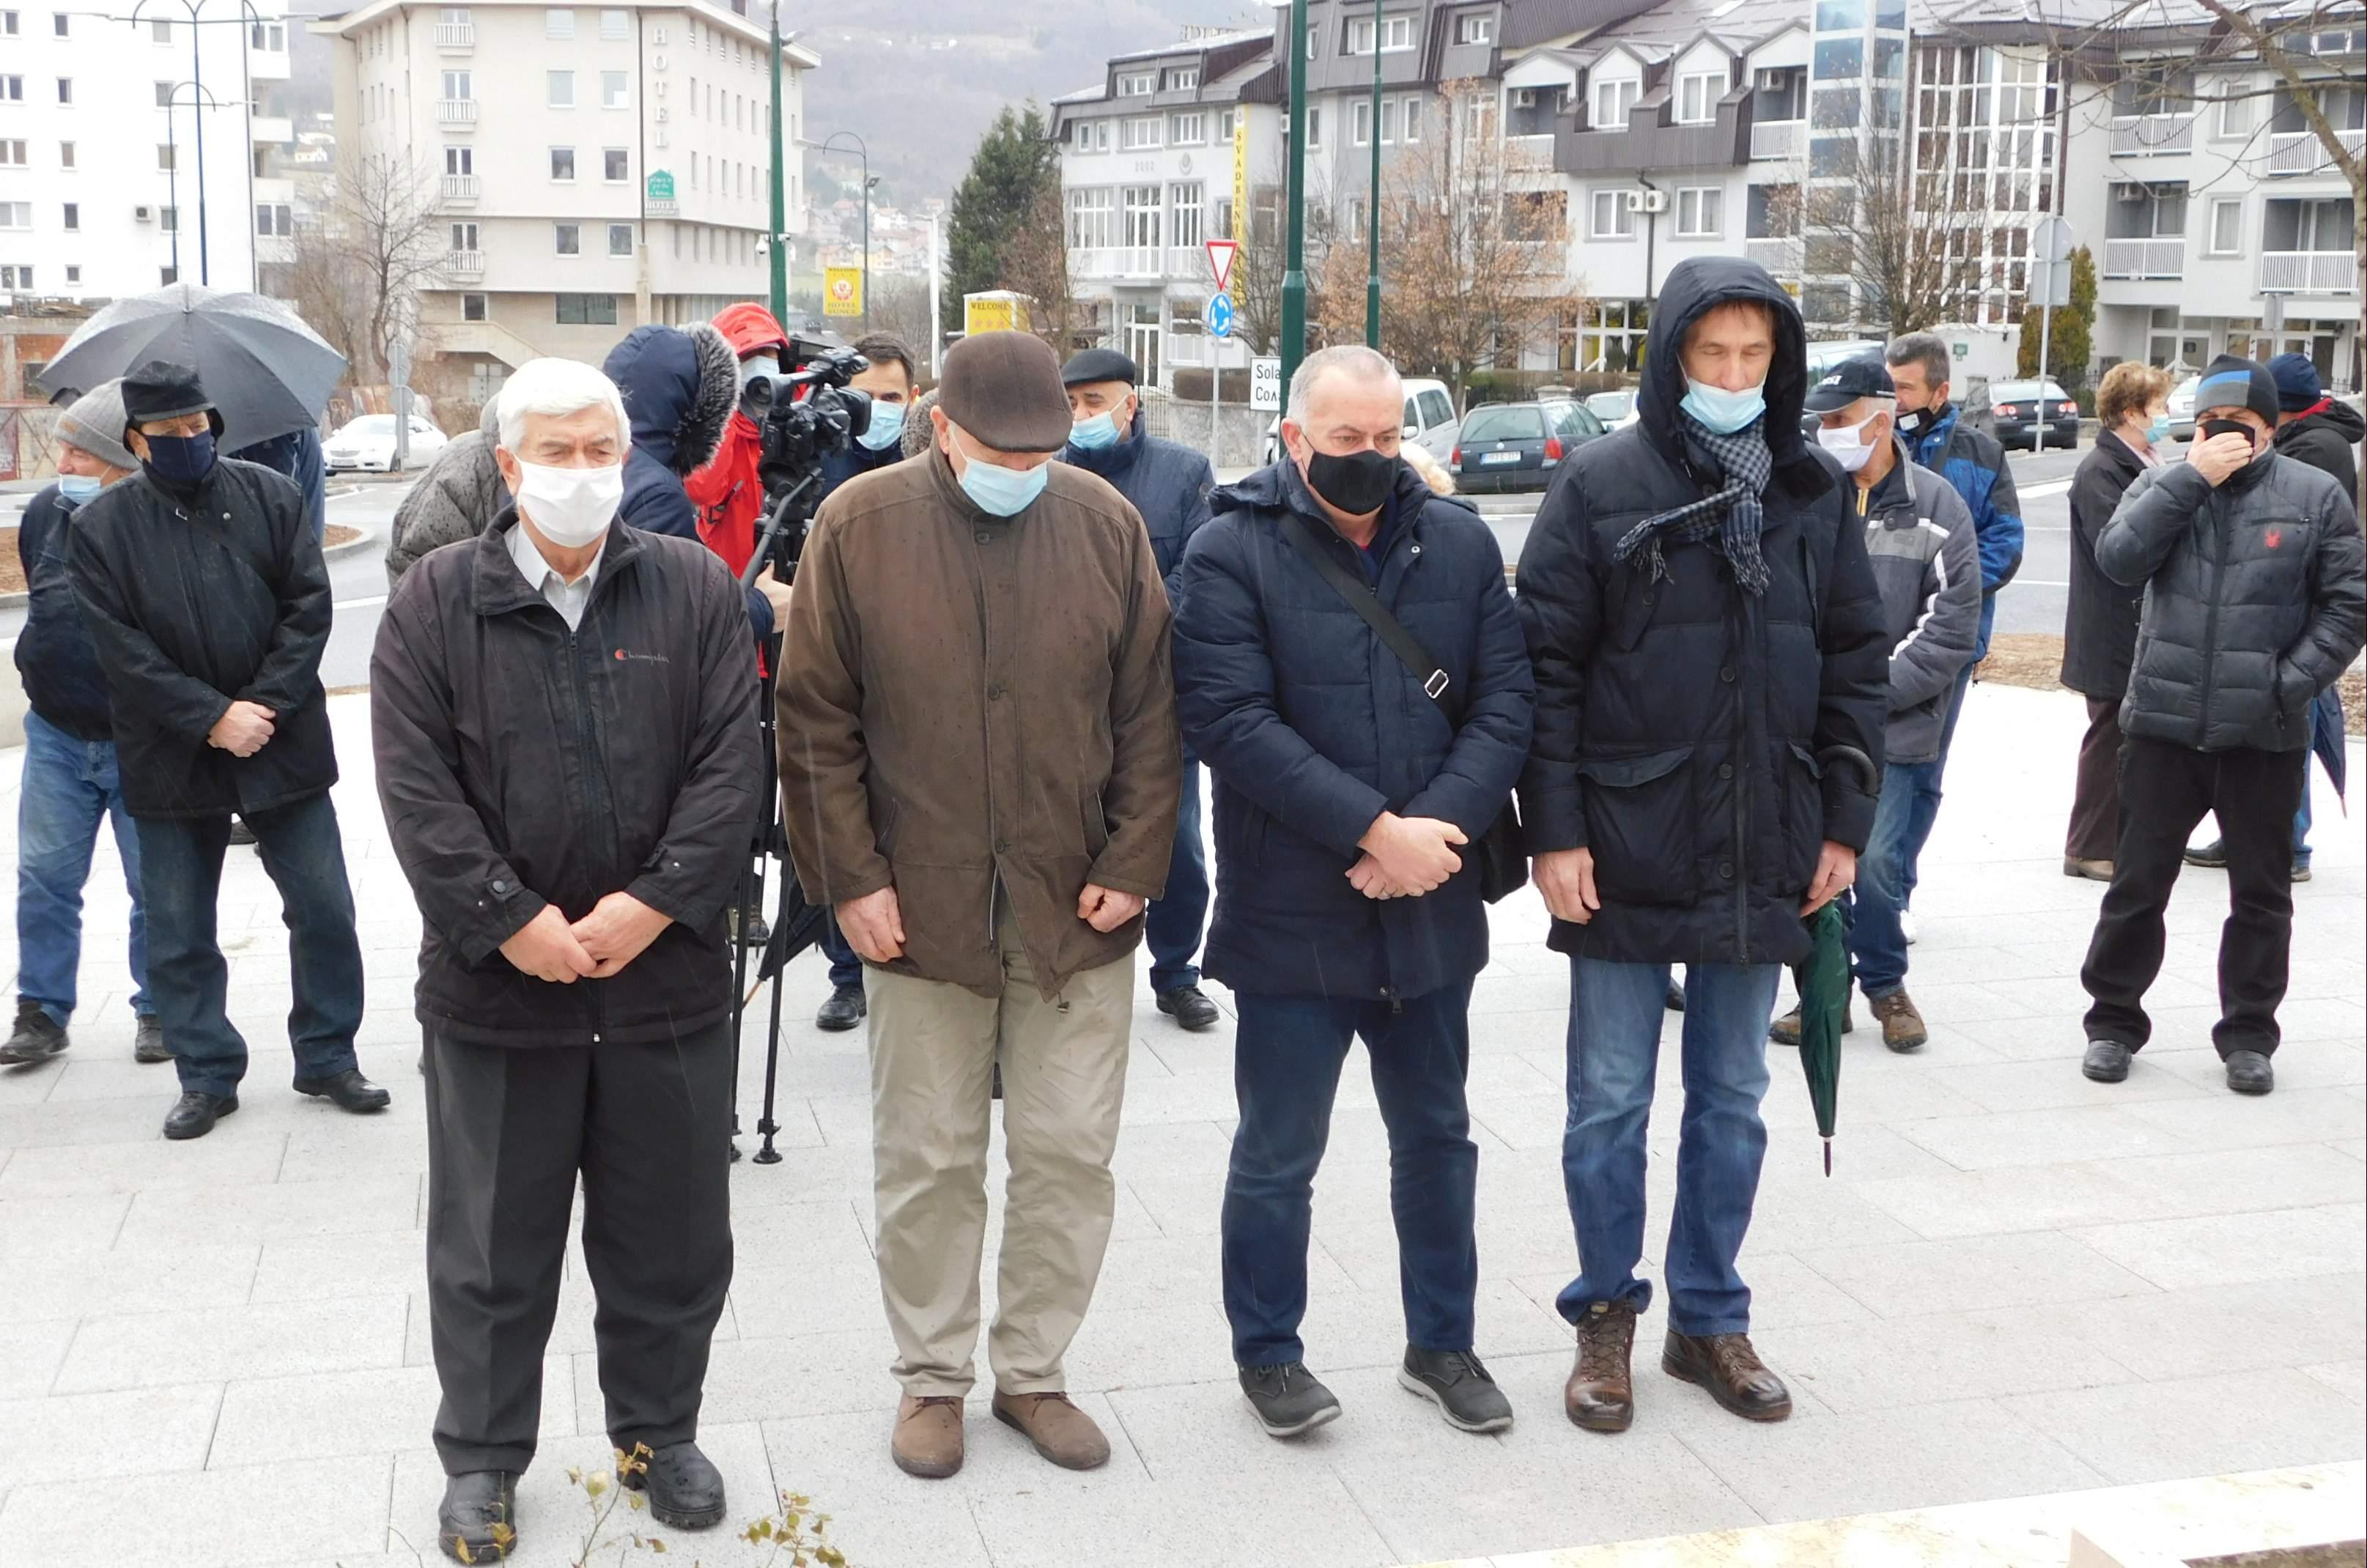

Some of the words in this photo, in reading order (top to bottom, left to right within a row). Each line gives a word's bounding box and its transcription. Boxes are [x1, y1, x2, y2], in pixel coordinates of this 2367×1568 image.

[652, 28, 668, 149] HOTEL
[970, 302, 1009, 311] WELCOME
[1256, 386, 1280, 402] Сол
